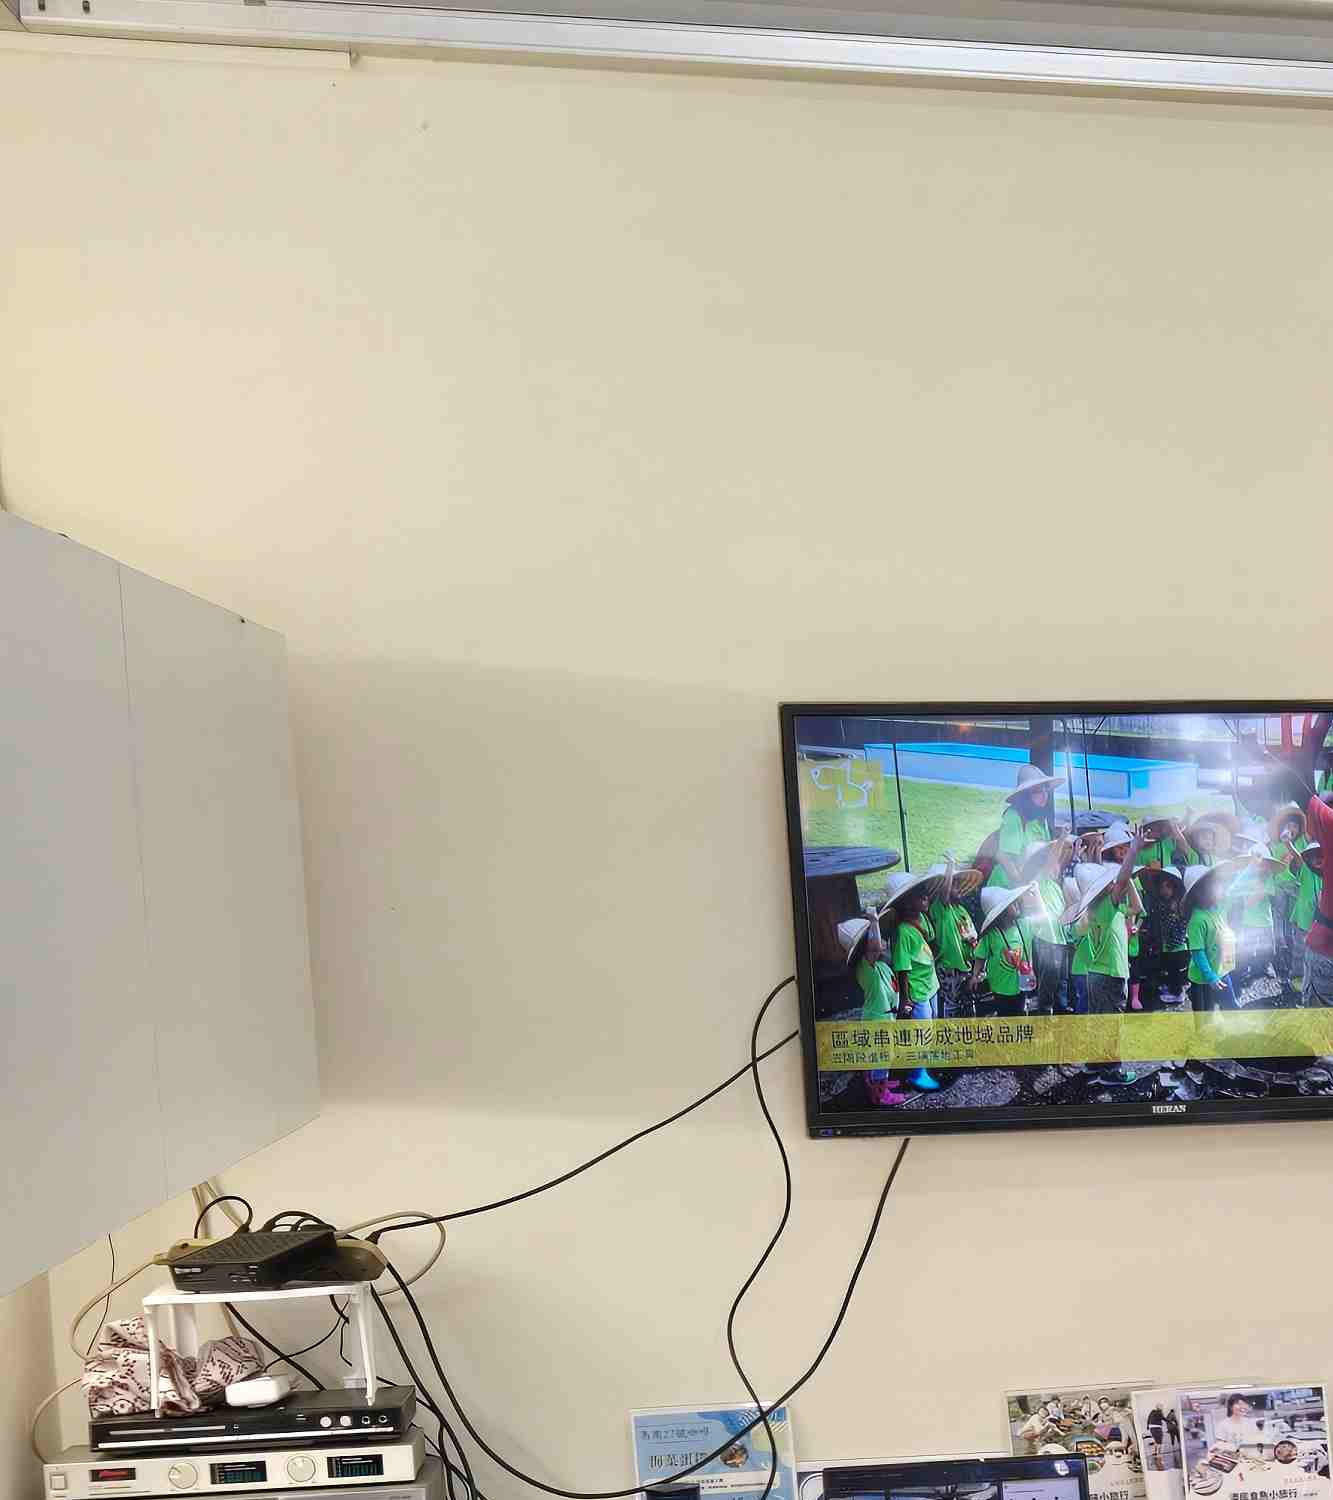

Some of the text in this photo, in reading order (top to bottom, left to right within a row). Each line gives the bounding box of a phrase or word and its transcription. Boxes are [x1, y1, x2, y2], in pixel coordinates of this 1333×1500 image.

[831, 1025, 1034, 1049] 區域串連形成地域品牌
